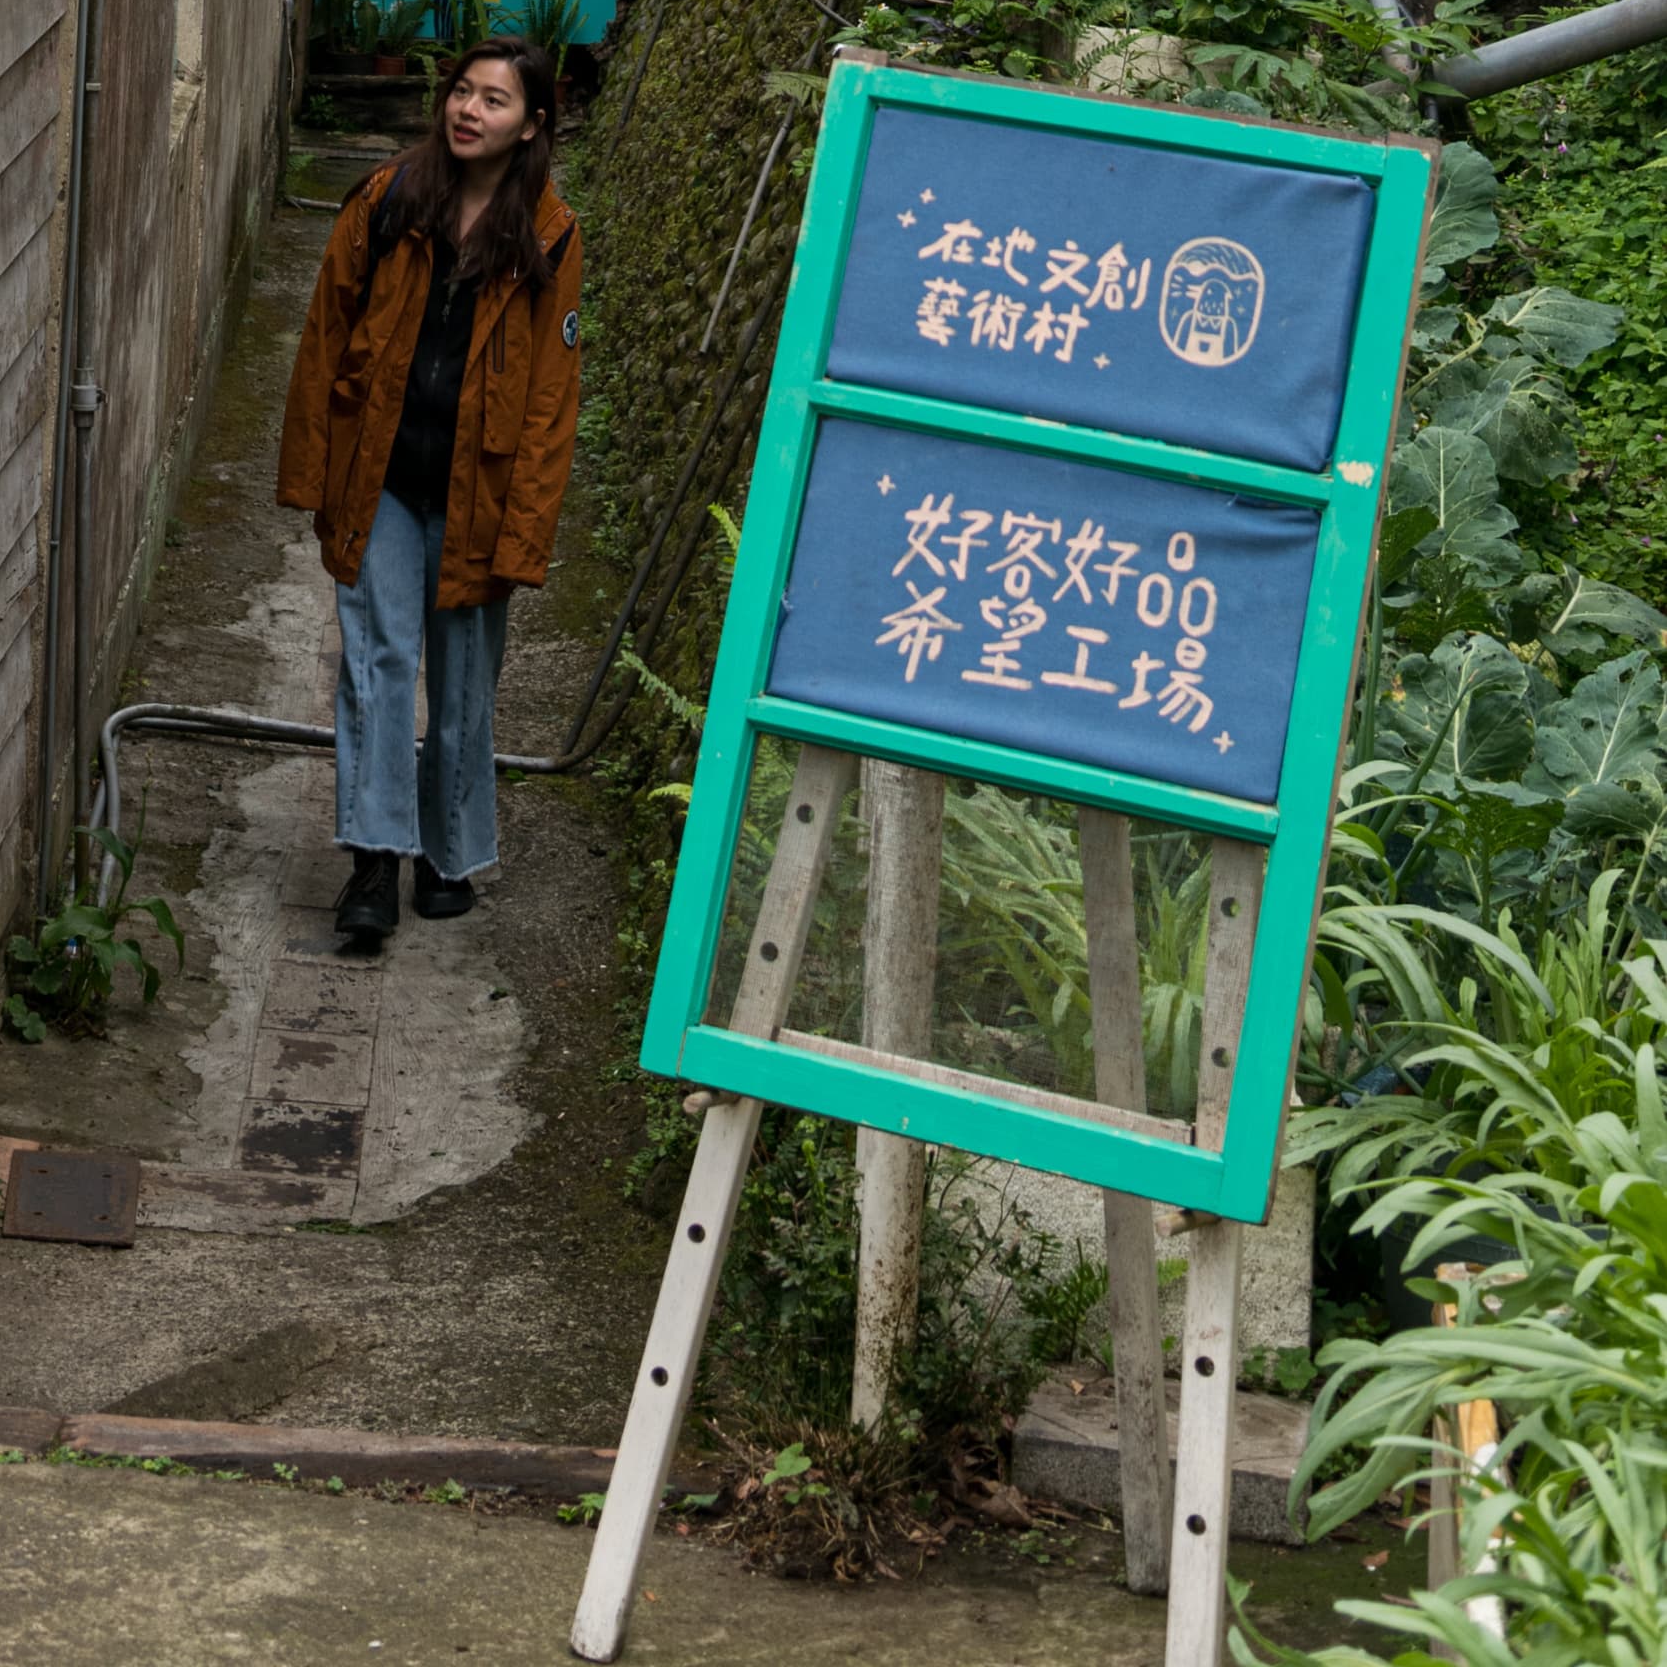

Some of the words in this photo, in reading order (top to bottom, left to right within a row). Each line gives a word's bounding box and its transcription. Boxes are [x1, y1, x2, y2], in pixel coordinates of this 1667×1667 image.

[917, 278, 1091, 364] 藝術村
[918, 219, 1149, 311] 在地文創
[892, 493, 1218, 639] 好客好品
[875, 580, 1215, 734] 希望工場
